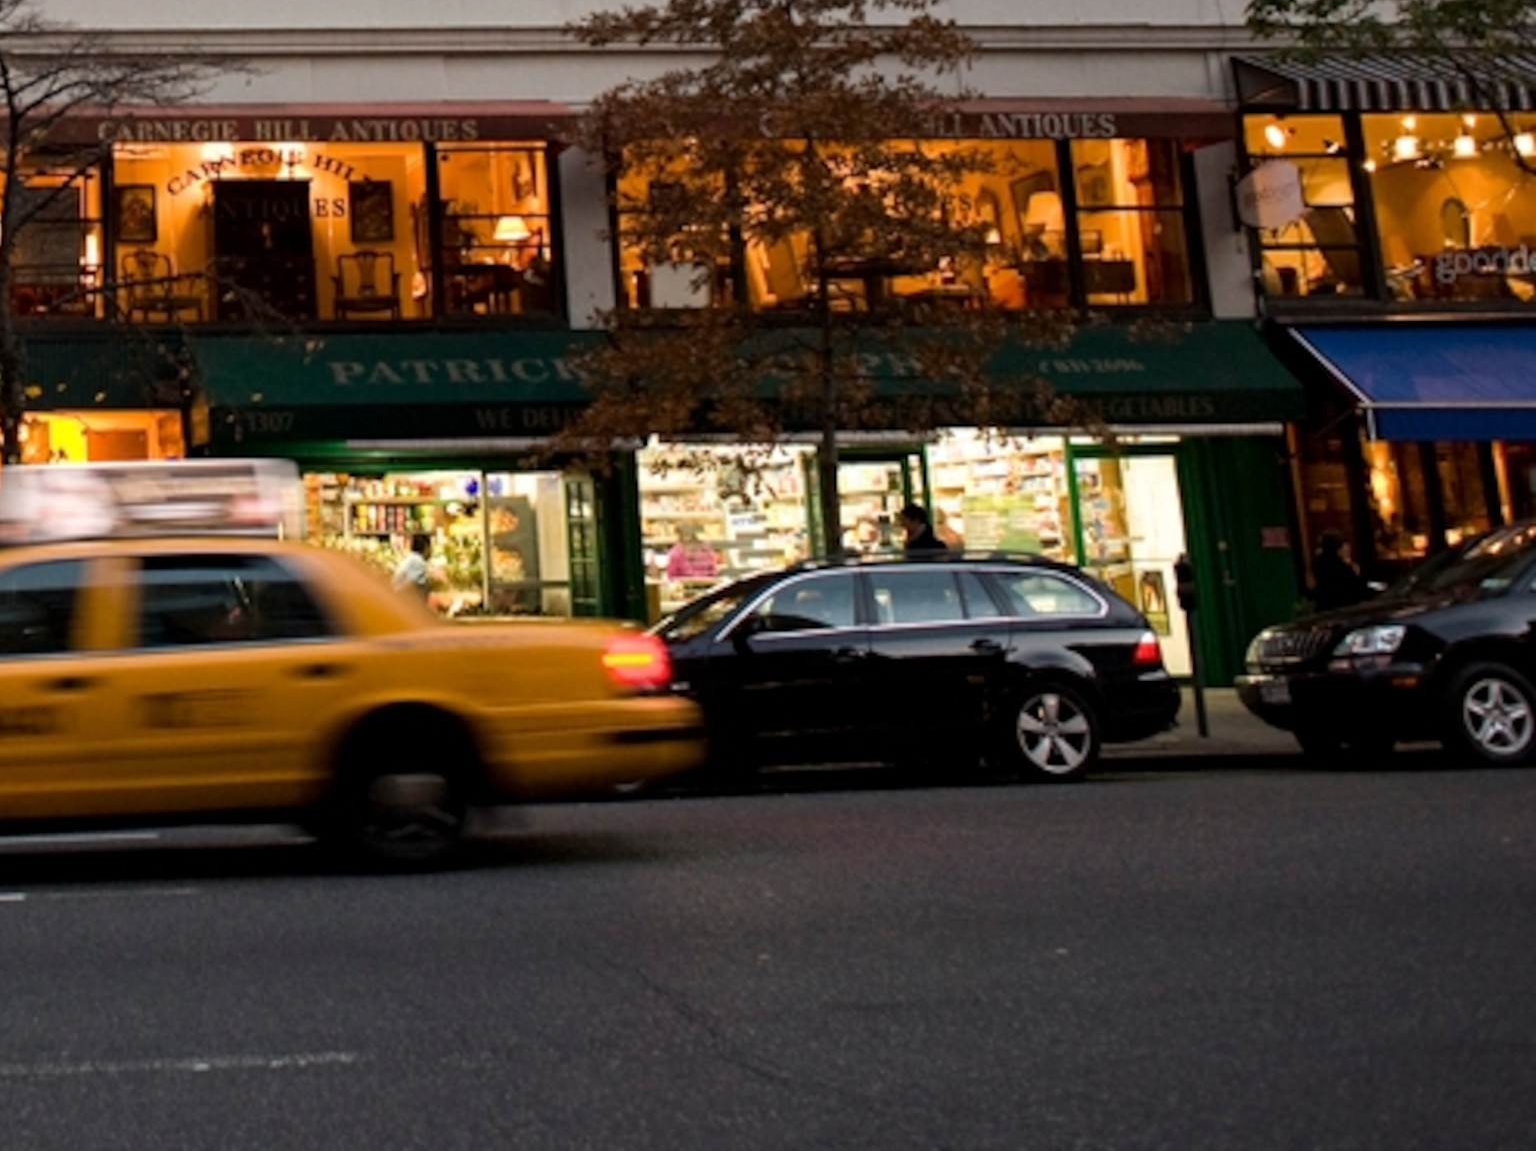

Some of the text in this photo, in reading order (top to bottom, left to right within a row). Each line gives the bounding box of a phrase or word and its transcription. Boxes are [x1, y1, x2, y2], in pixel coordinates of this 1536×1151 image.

[97, 119, 480, 142] CARNEGIE HILL ANTIQUES
[979, 113, 1117, 139] ANTIQUES
[166, 148, 303, 197] CARNEGIE
[326, 357, 588, 386] PATRICK
[244, 411, 294, 432] 1307
[476, 407, 513, 429] WE
